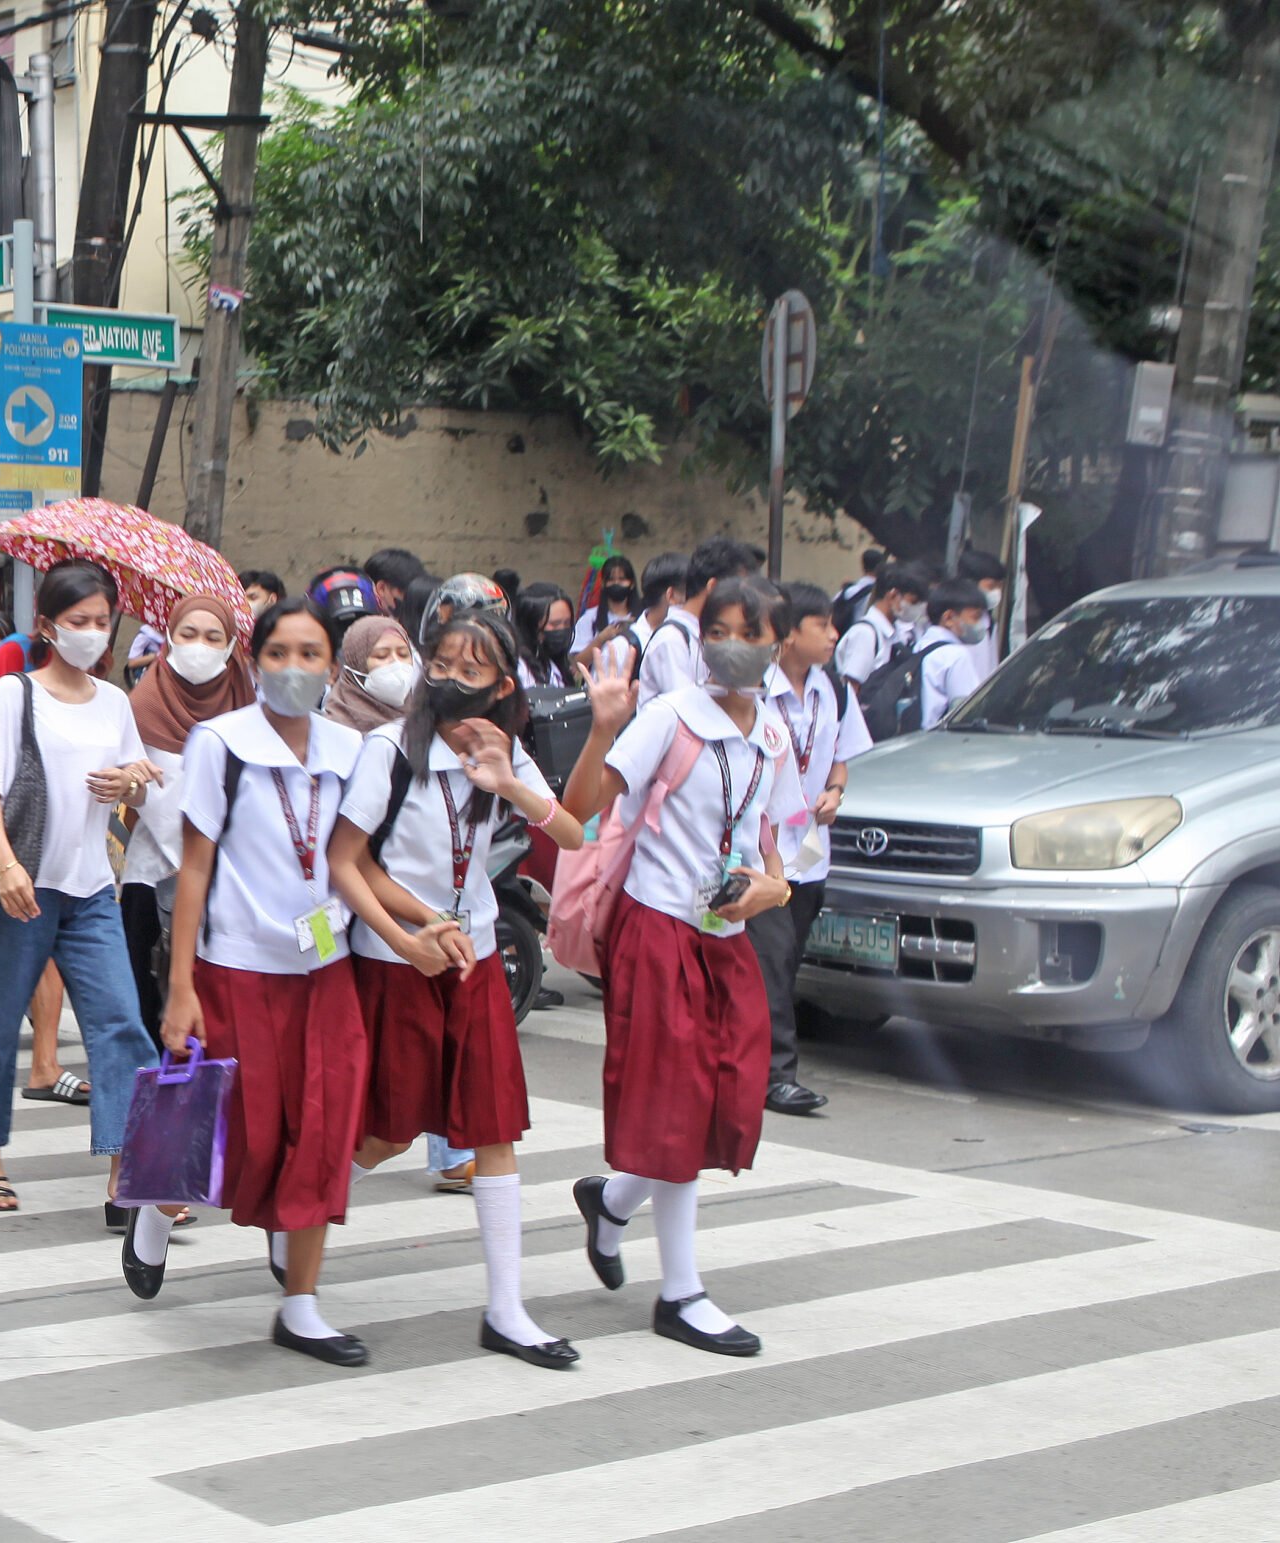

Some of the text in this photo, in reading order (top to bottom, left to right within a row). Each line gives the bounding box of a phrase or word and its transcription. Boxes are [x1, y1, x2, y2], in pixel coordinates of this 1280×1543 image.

[20, 332, 48, 344] MANILA
[99, 325, 138, 351] NATION
[142, 329, 165, 352] AVE.
[4, 344, 62, 359] POLICE DISTRICT
[48, 447, 69, 462] 911
[853, 922, 891, 951] 505
